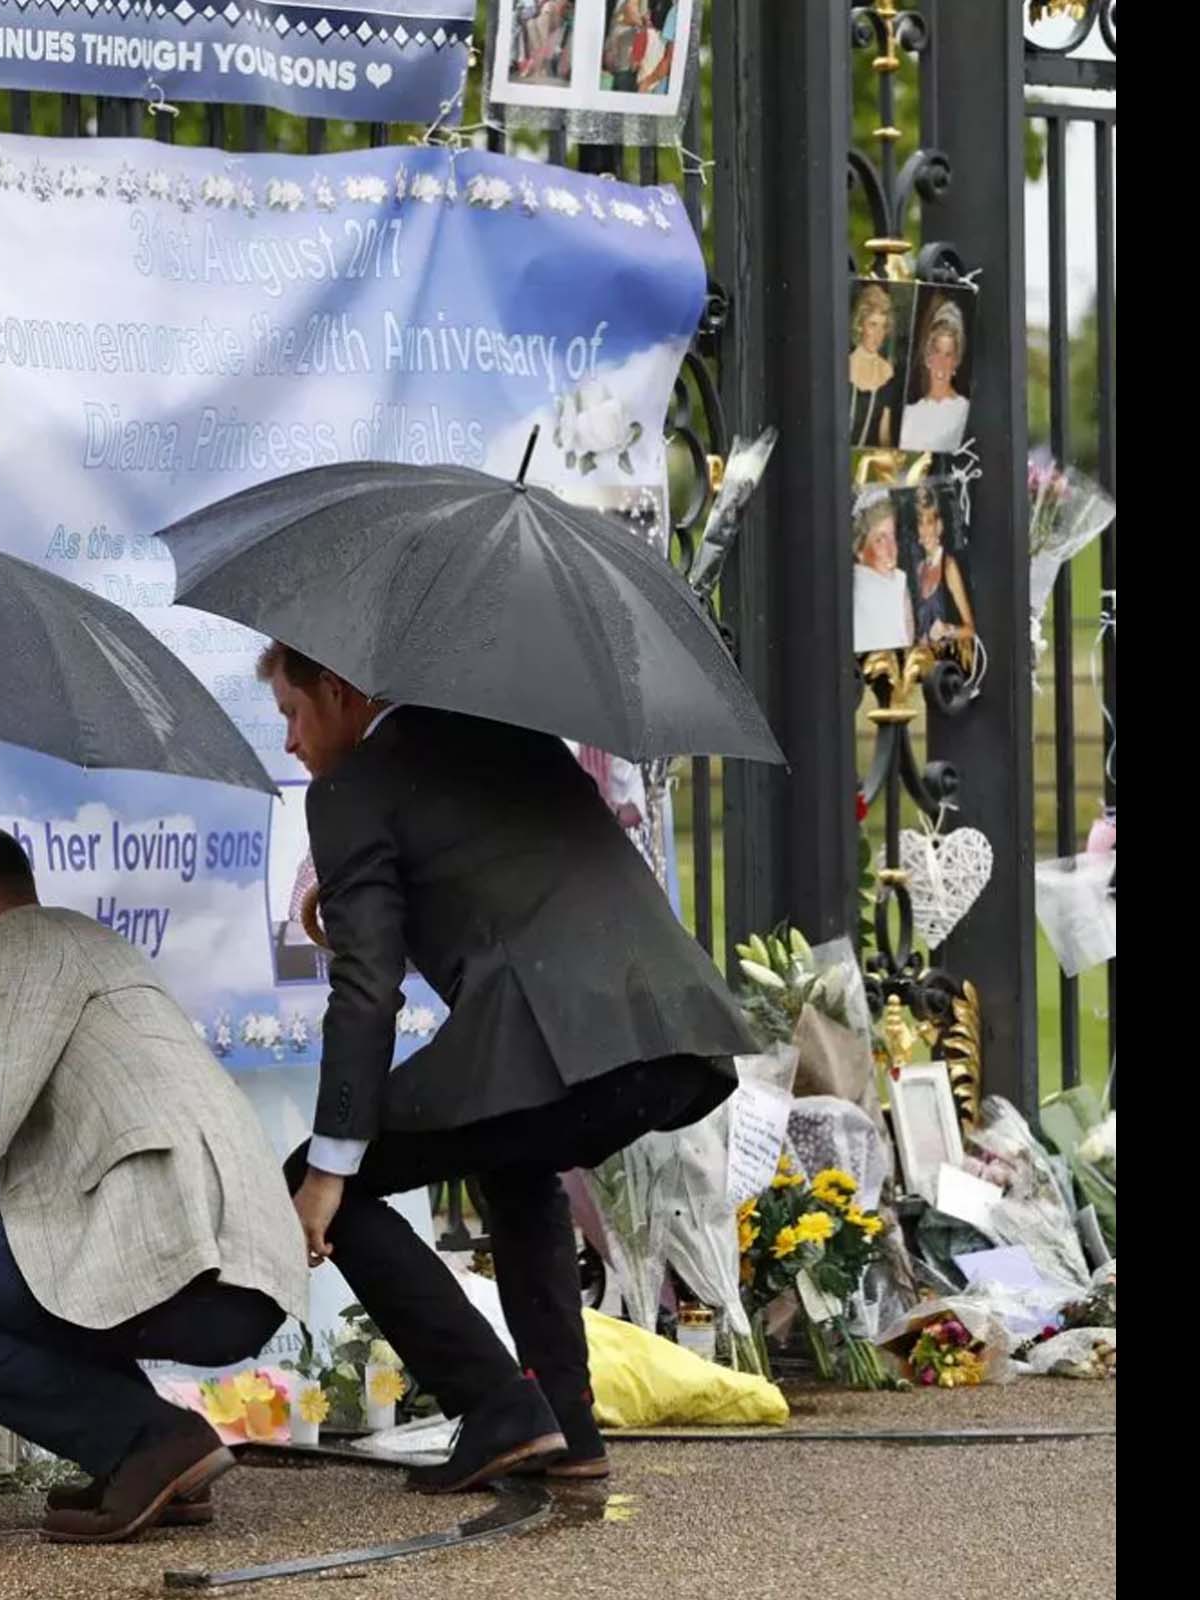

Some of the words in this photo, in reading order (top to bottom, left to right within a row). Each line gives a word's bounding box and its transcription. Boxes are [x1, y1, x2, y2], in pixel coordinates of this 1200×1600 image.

[82, 34, 202, 72] THROUGH
[212, 43, 278, 82] YOUR
[279, 55, 357, 91] SONS
[203, 218, 341, 297] August
[565, 320, 609, 381] of
[45, 523, 81, 560] As
[87, 523, 127, 560] the
[131, 531, 173, 561] su
[45, 821, 101, 871] her
[113, 820, 197, 883] loving
[205, 830, 265, 869] sons
